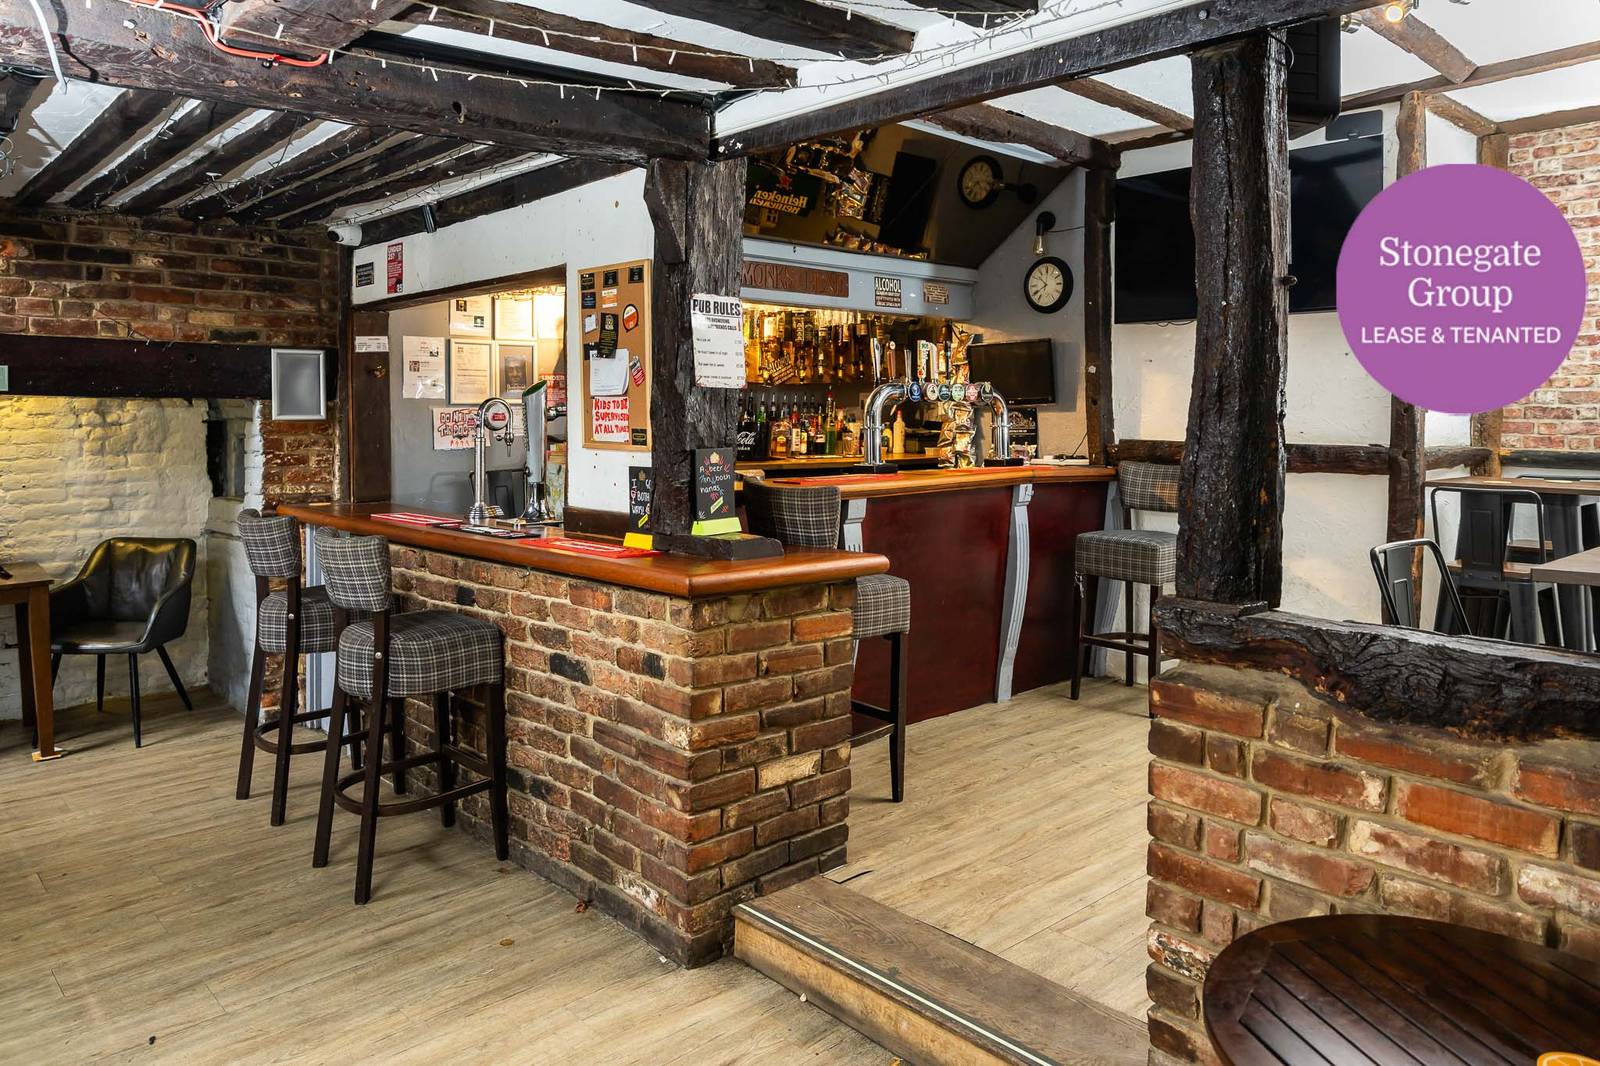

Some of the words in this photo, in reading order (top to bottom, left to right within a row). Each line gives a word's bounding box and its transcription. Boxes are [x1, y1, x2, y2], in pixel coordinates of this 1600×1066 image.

[742, 263, 793, 289] MONKS
[875, 277, 902, 293] ALCOHOL
[692, 299, 711, 314] PUB
[713, 301, 741, 316] RULES
[594, 398, 611, 410] KIDS
[613, 400, 620, 409] TO
[594, 424, 603, 434] AT
[603, 424, 614, 433] ALL
[736, 431, 756, 445] Cola
